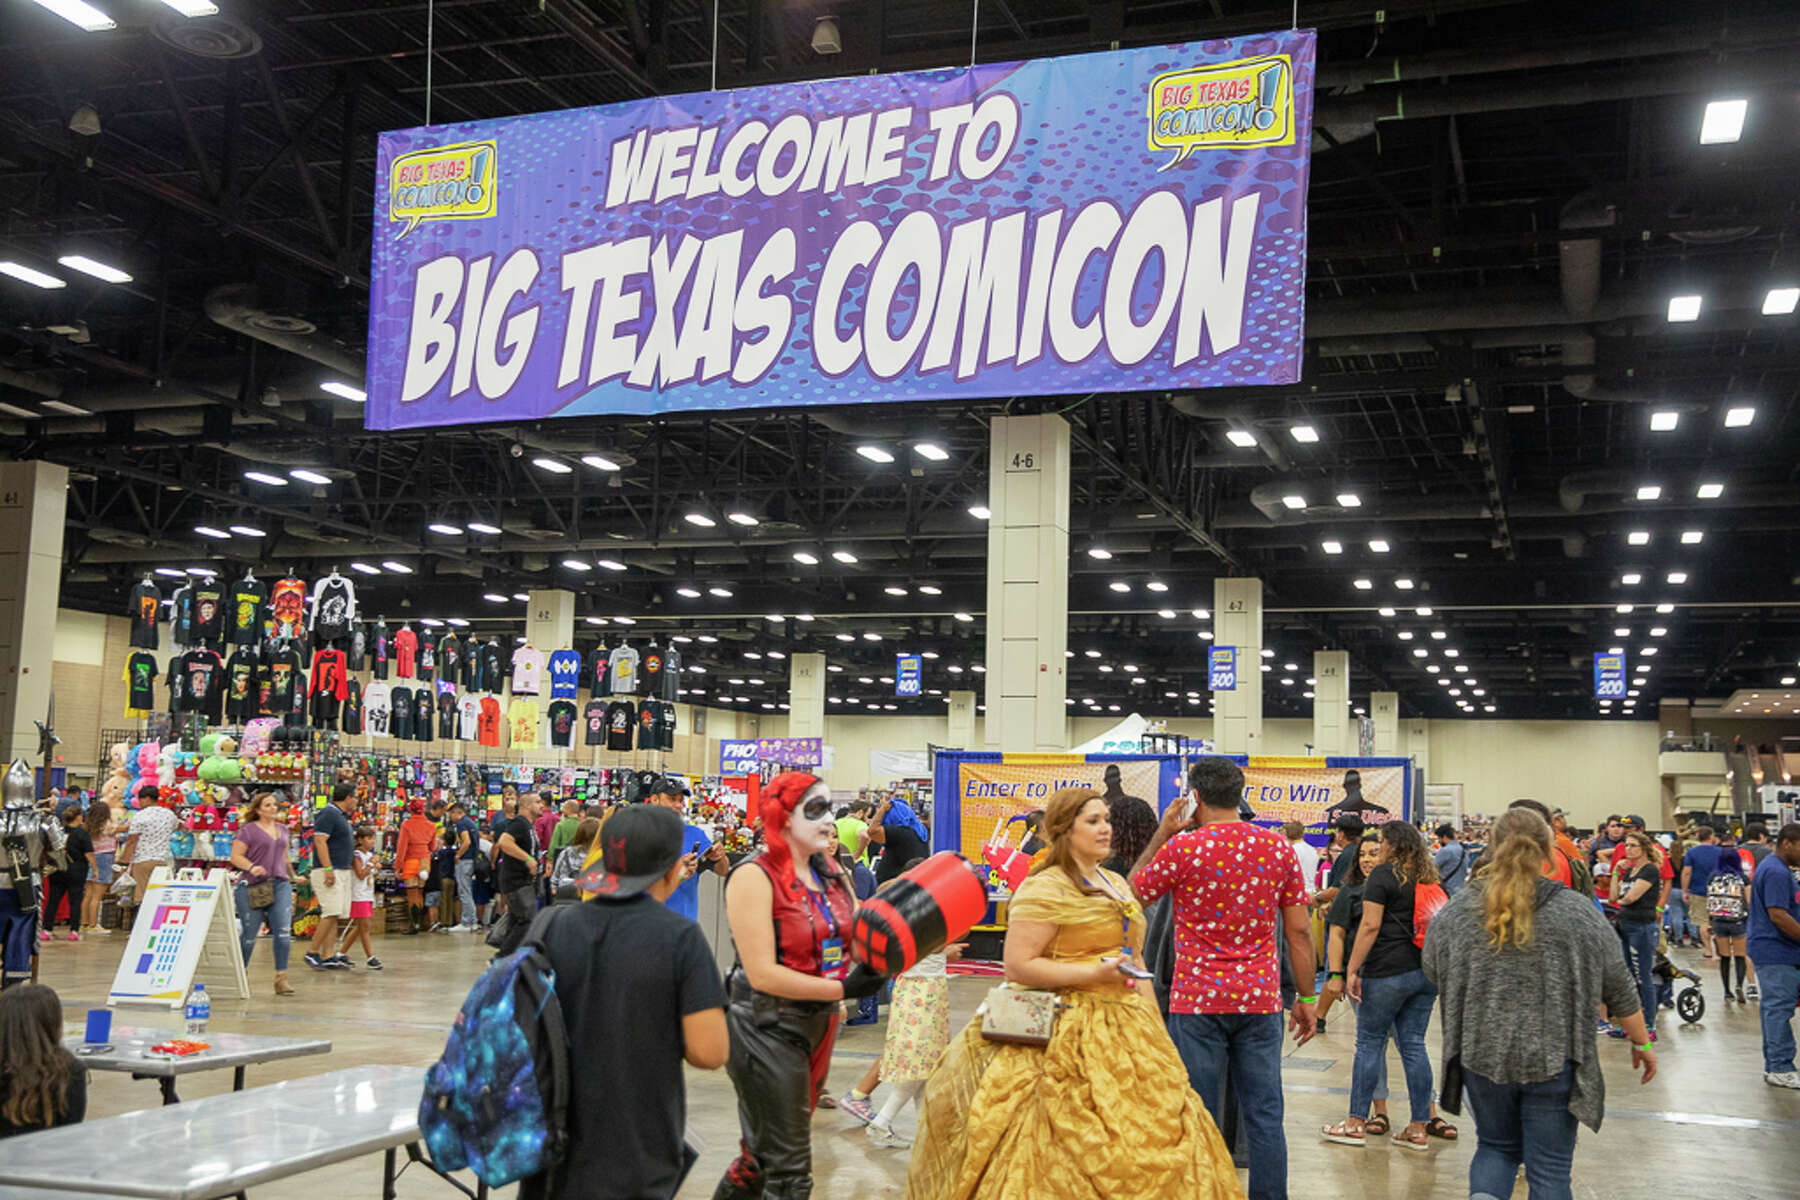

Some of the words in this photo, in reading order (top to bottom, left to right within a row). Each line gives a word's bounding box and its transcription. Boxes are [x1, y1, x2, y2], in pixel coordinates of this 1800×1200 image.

[1161, 85, 1193, 107] BIG
[1199, 76, 1251, 103] TEXAS
[606, 107, 912, 208] WELCOME
[929, 95, 1018, 182] TO
[399, 164, 424, 184] BIG
[427, 159, 466, 181] TEXAS
[401, 249, 540, 401] BIG
[557, 228, 796, 389] TEXAS
[813, 191, 1261, 378] COMICON
[898, 679, 918, 692] 400
[1211, 672, 1234, 688] 300
[1597, 680, 1624, 695] 200
[723, 743, 758, 758] PHO
[965, 779, 1021, 798] Enter
[1026, 782, 1047, 798] to
[1260, 785, 1282, 802] to
[1290, 783, 1330, 802] Win
